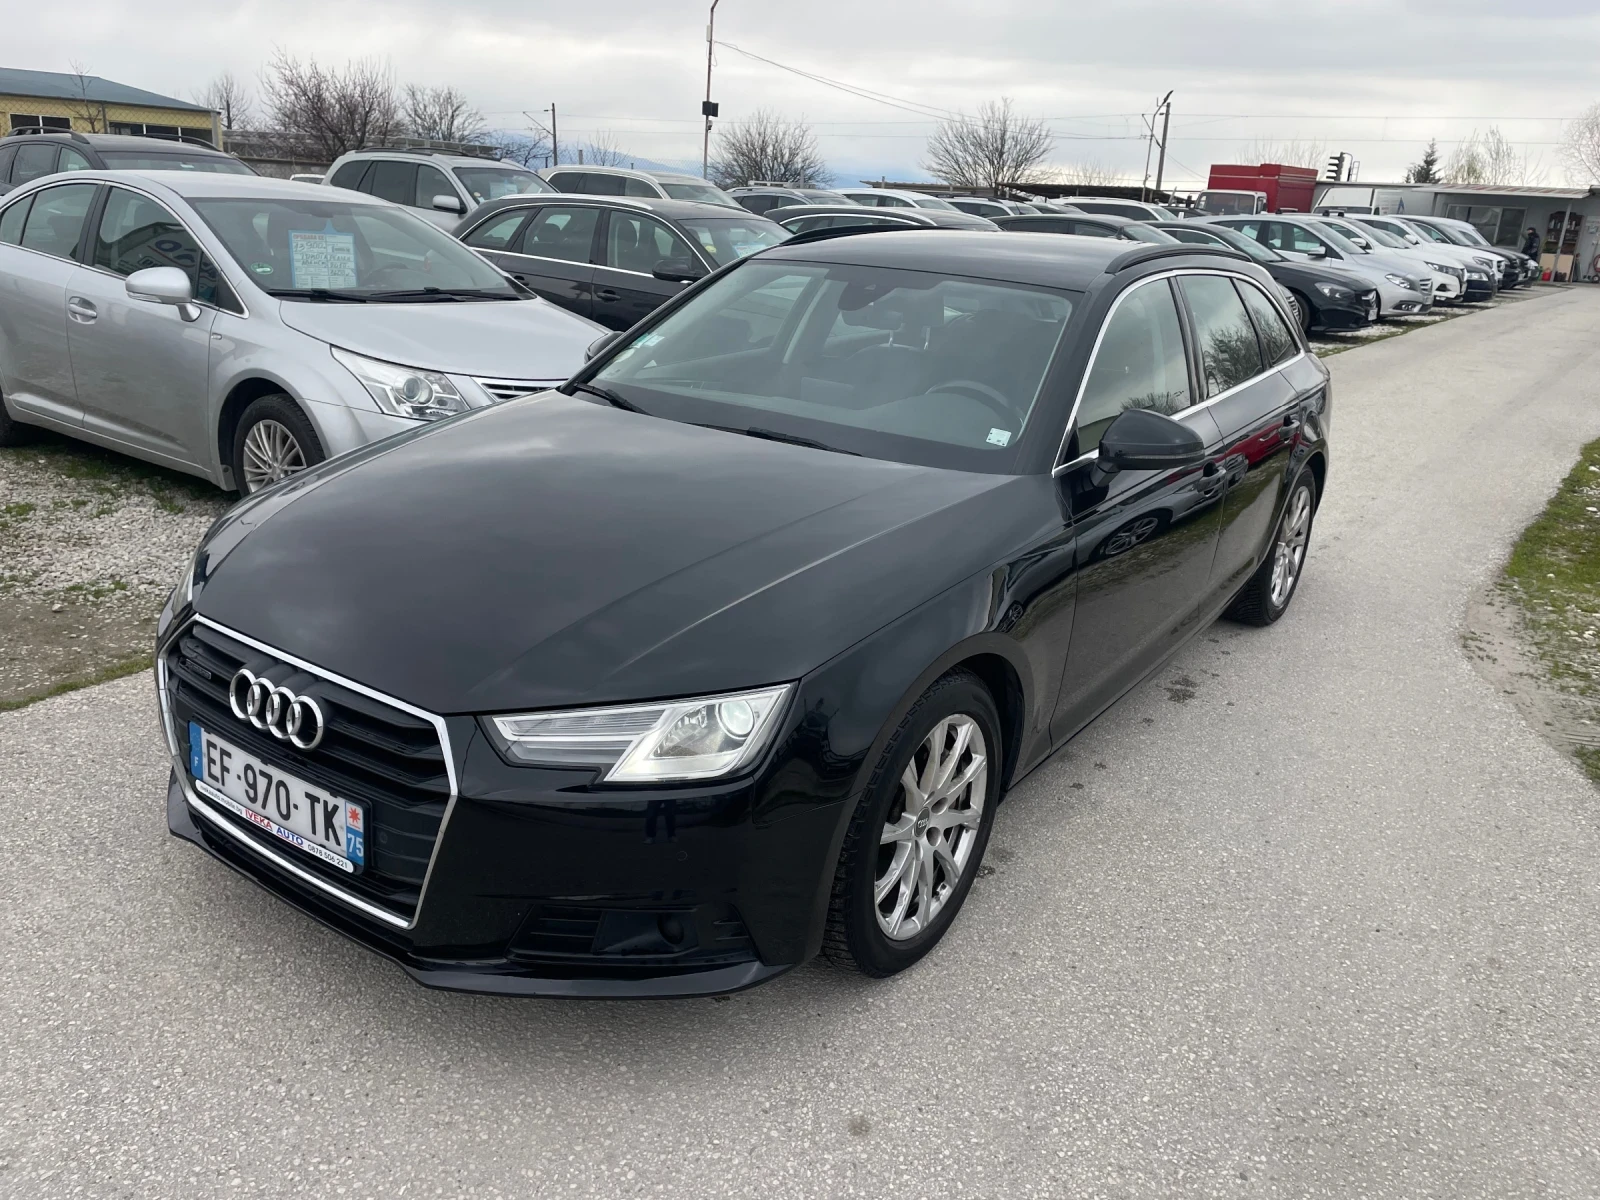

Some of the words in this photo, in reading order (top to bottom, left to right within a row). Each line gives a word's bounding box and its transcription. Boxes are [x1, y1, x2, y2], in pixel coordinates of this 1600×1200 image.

[194, 756, 199, 767] F
[245, 808, 273, 830] IVEKA
[276, 826, 304, 847] AUTO
[307, 843, 323, 857] 0878
[324, 852, 335, 863] 506
[336, 858, 348, 869] 221
[347, 833, 363, 857] 75
